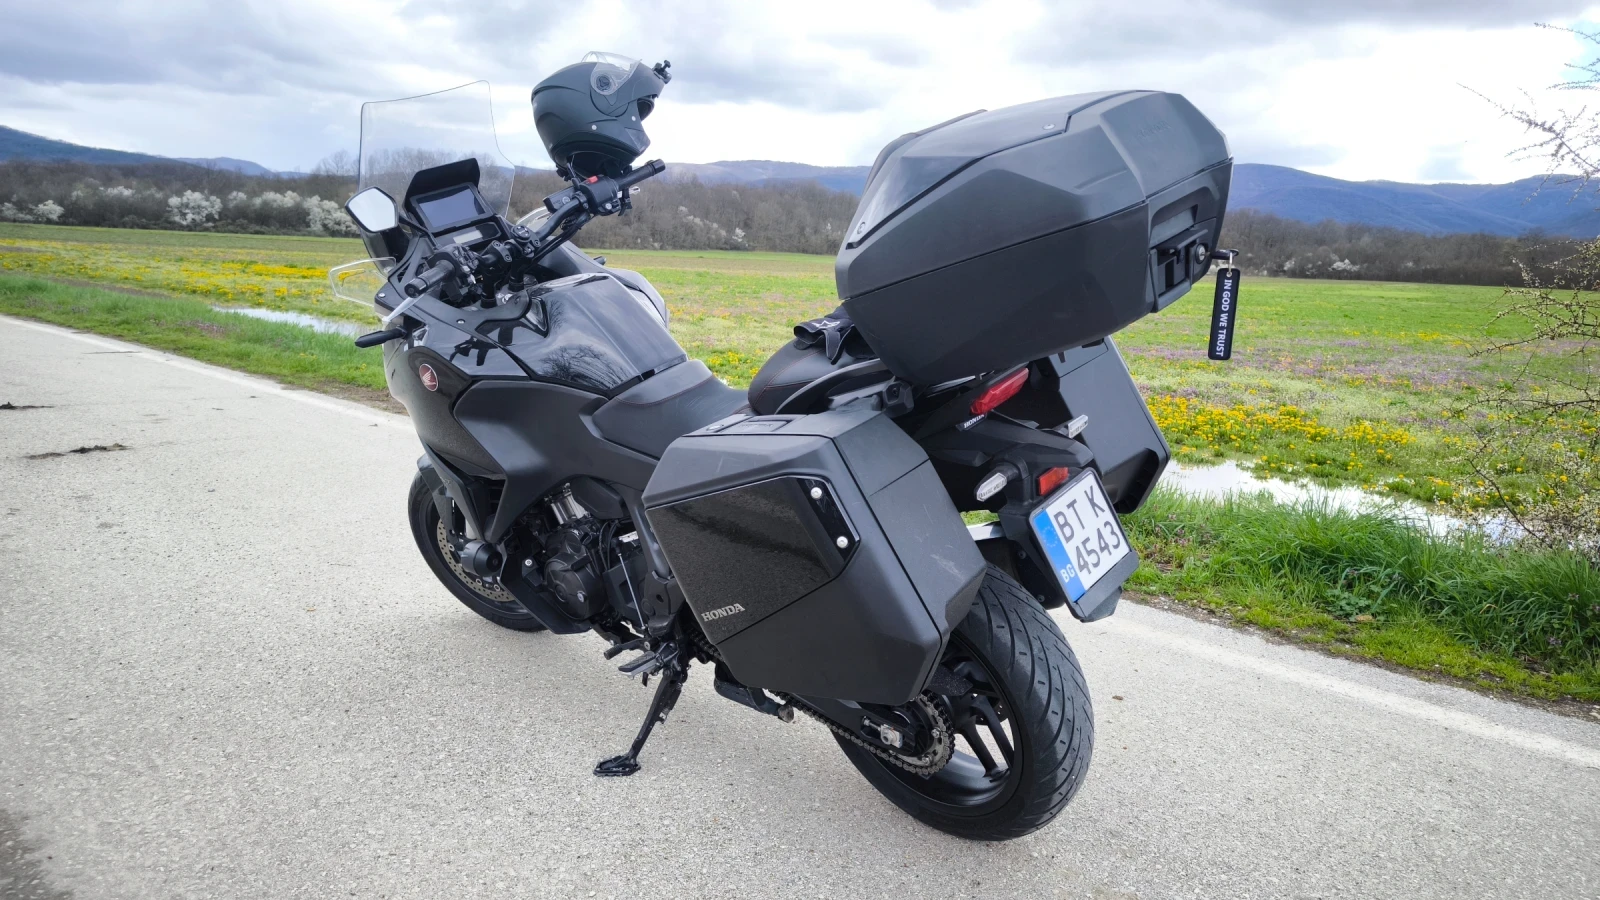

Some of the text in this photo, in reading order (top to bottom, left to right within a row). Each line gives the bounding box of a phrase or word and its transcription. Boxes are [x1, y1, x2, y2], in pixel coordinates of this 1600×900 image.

[1216, 279, 1232, 356] IN GOD WE TRUST
[1053, 485, 1105, 544] BT K
[1060, 564, 1076, 583] BG
[1075, 521, 1121, 575] 4543
[701, 603, 746, 622] HONDA
